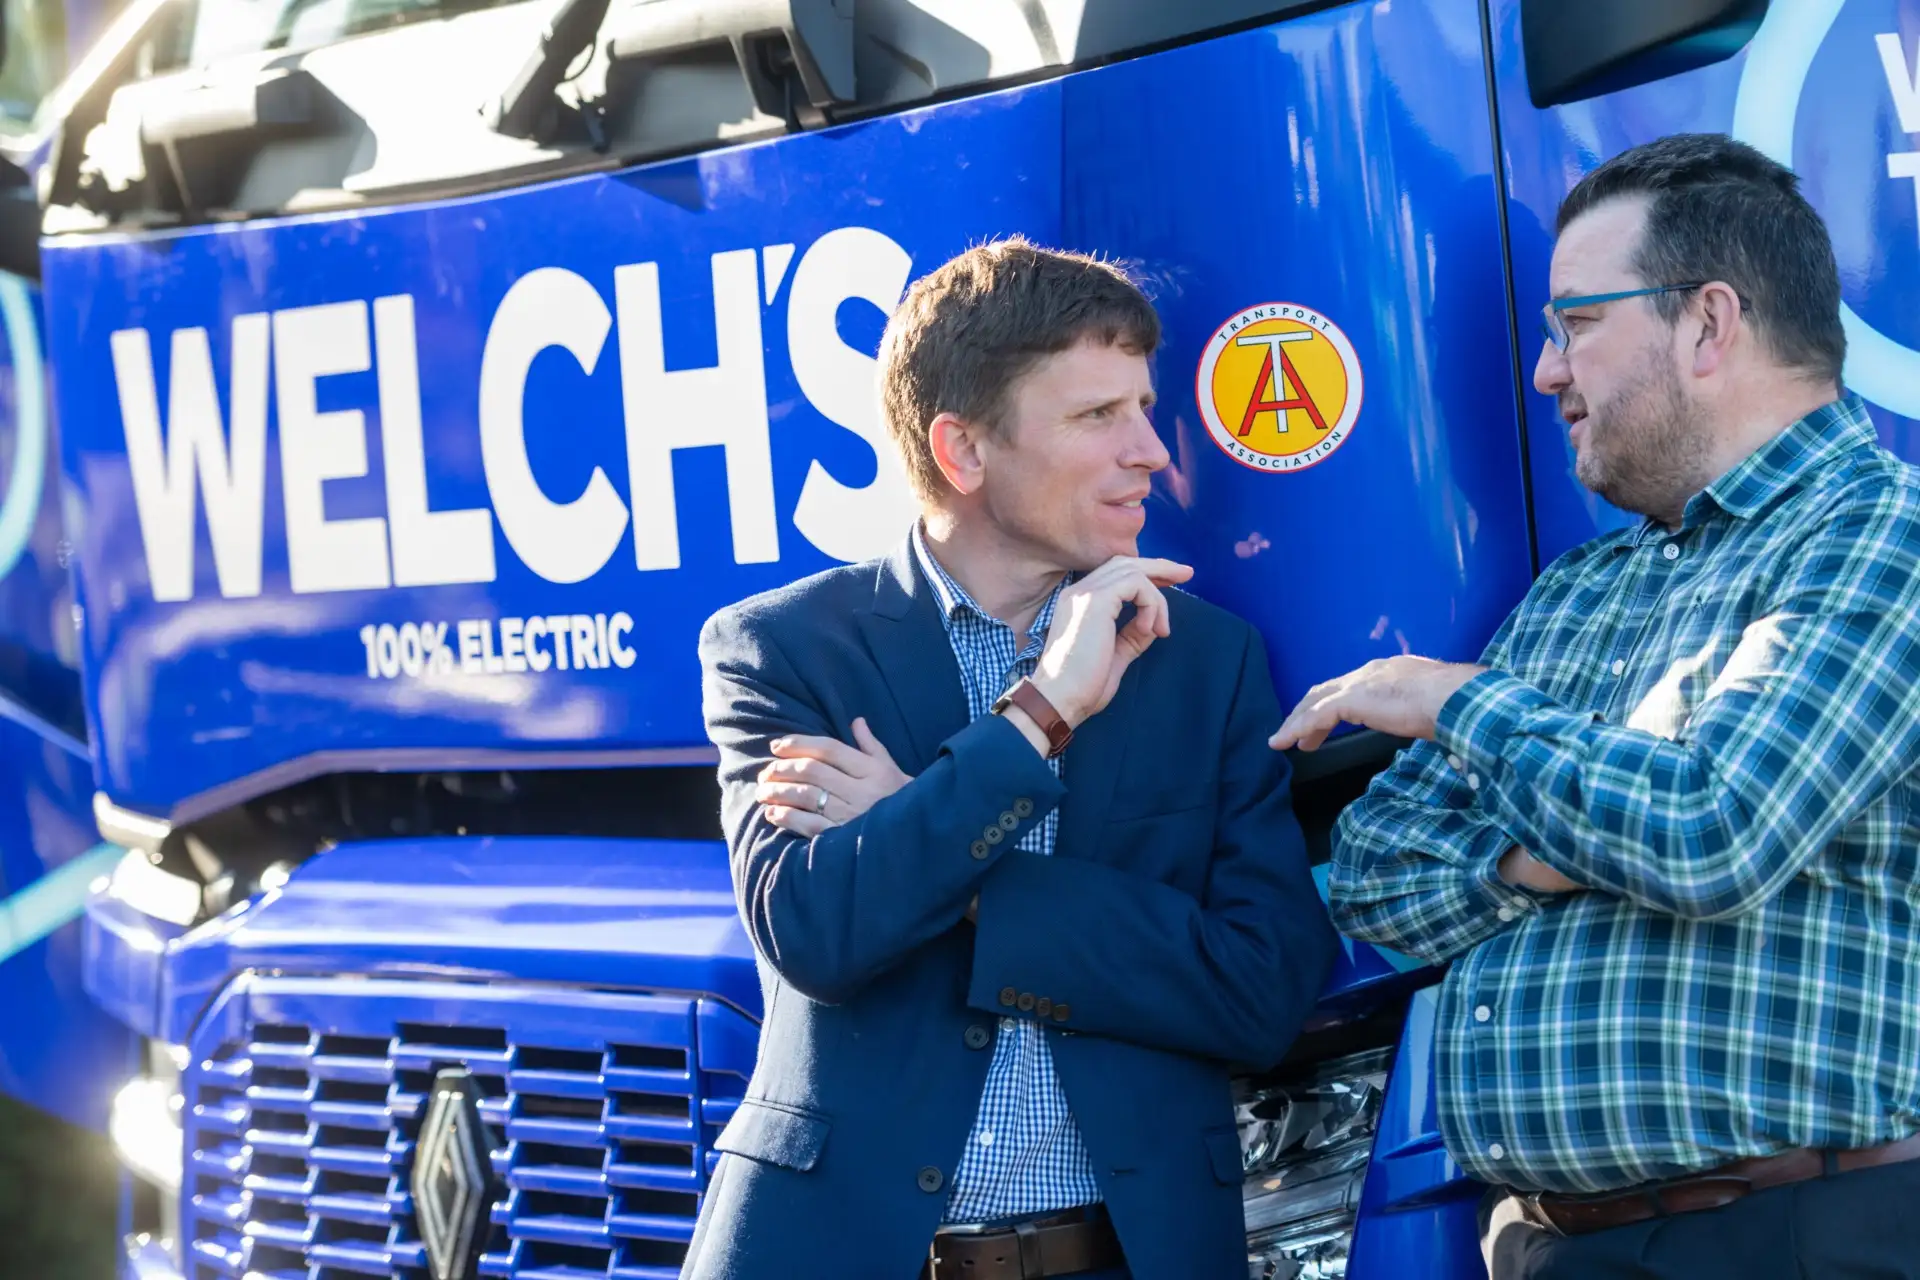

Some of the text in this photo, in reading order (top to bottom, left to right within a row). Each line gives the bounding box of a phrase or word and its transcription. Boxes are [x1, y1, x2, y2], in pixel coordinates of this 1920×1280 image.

[1218, 307, 1330, 341] TRANSPORT
[110, 226, 918, 602] WELCH'S
[1227, 432, 1341, 468] ASSOCIATION
[359, 611, 637, 679] 100% ELECTRIC
